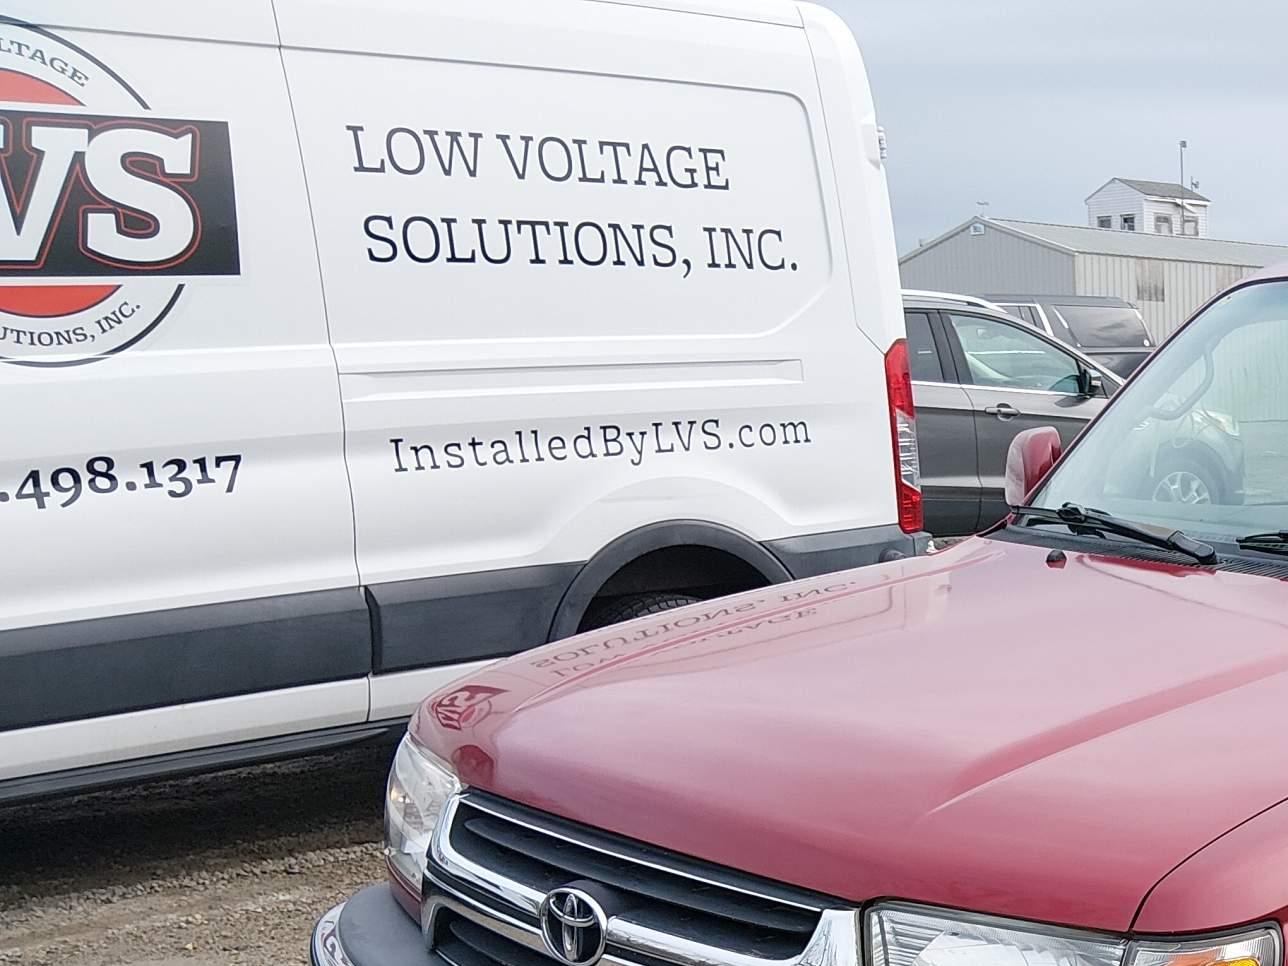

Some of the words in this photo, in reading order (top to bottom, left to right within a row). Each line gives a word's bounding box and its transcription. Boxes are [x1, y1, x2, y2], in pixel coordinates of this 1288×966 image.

[345, 125, 484, 178] LOW
[495, 133, 730, 191] VOLTAGE
[363, 214, 692, 279] SOLUTIONS,
[702, 226, 798, 272] INC.
[94, 301, 141, 335] INC.
[389, 418, 812, 473] InstalledByLVS.com
